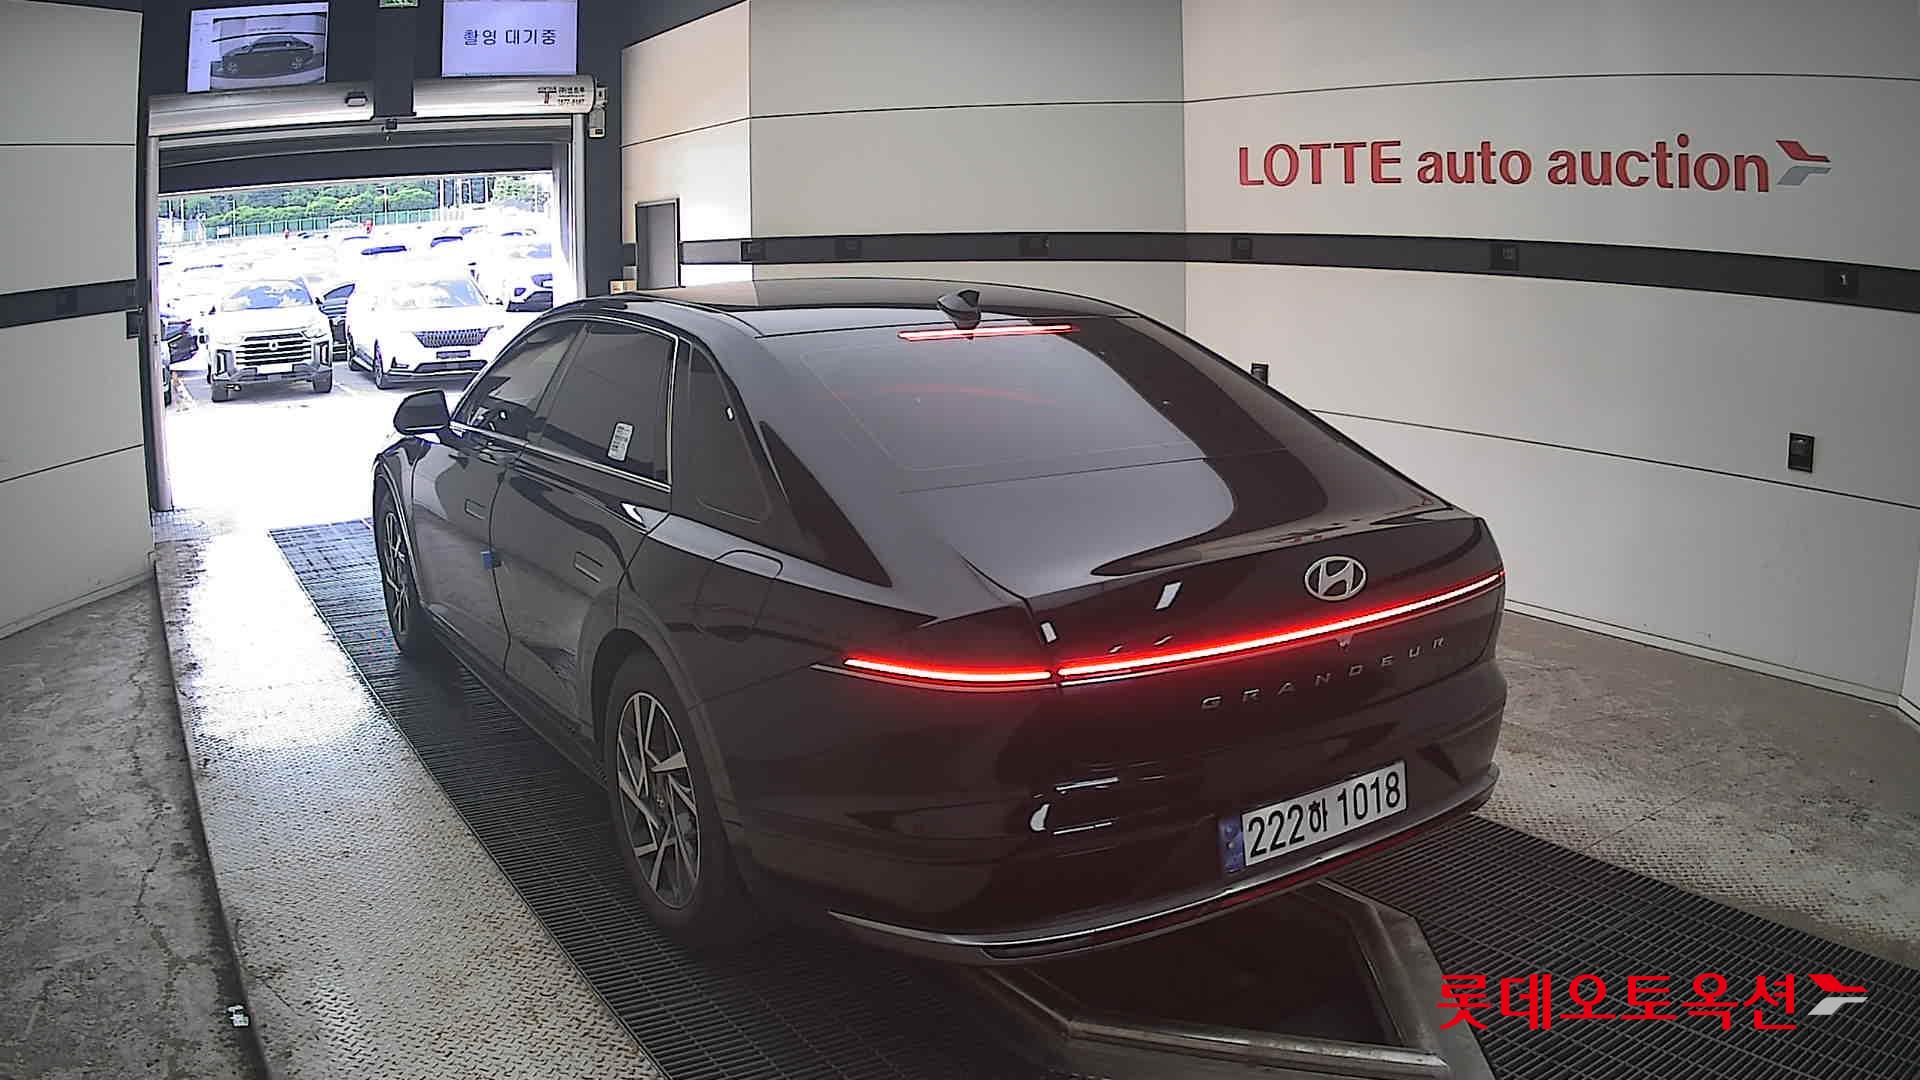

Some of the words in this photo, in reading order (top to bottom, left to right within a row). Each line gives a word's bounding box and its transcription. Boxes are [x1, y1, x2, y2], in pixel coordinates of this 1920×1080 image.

[505, 29, 556, 46] 대기중
[1238, 140, 1401, 187] LOTTE
[1416, 141, 1533, 186] auto
[1547, 133, 1770, 193] auction
[1201, 635, 1447, 709] GRANDEUR
[1248, 797, 1328, 858] 222하
[1337, 771, 1401, 826] 1018
